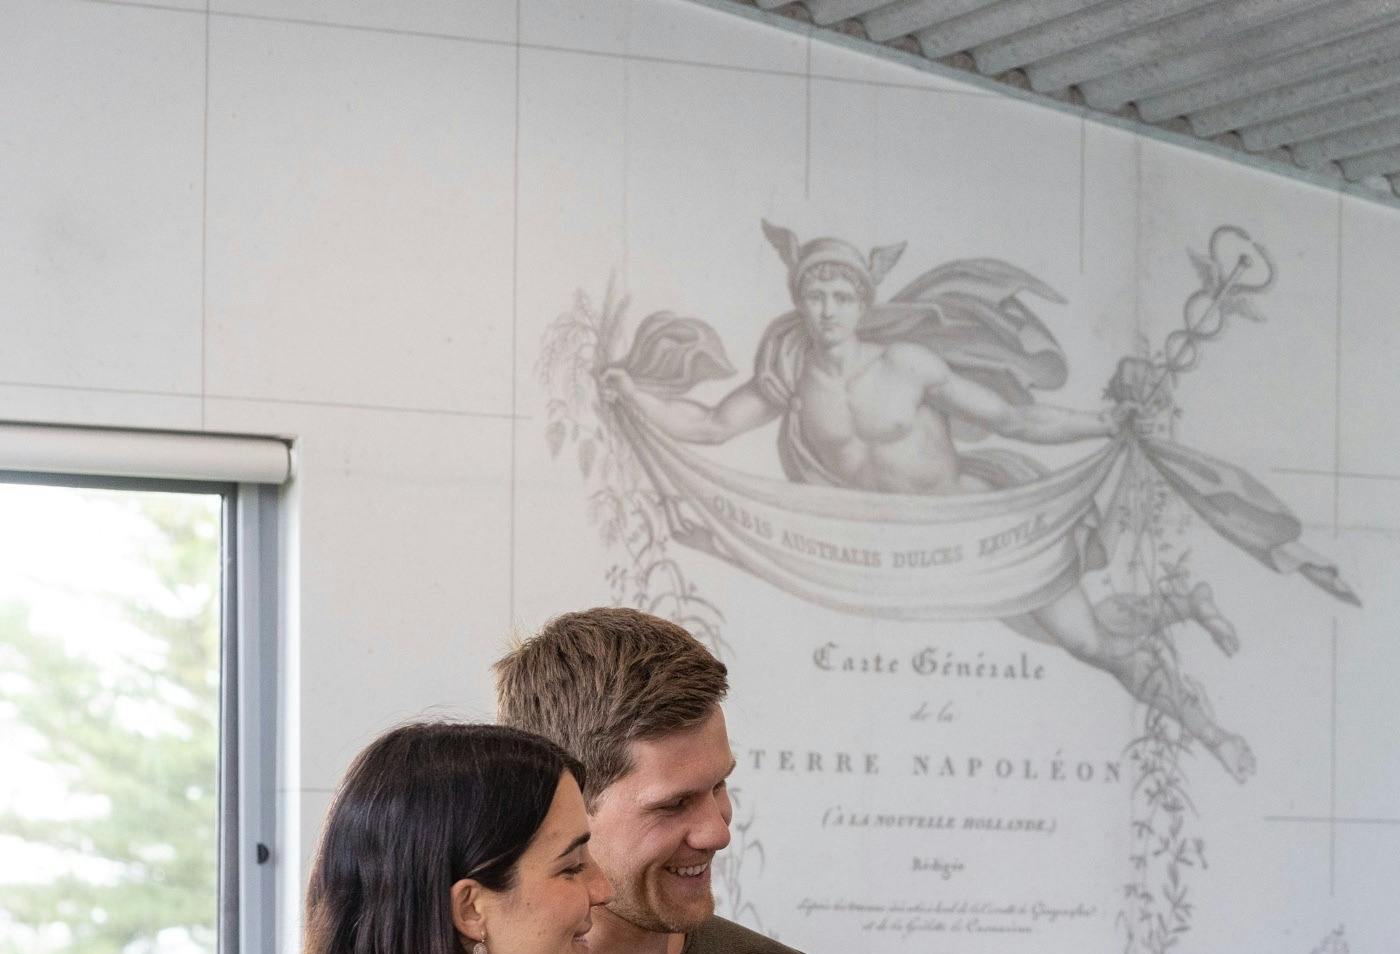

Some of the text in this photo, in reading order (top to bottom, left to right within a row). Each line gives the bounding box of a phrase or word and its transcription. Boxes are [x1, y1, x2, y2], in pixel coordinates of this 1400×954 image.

[892, 545, 963, 568] DULCES
[812, 642, 1045, 680] Carte Générale
[749, 749, 1121, 783] TERRE NAPOLÉON
